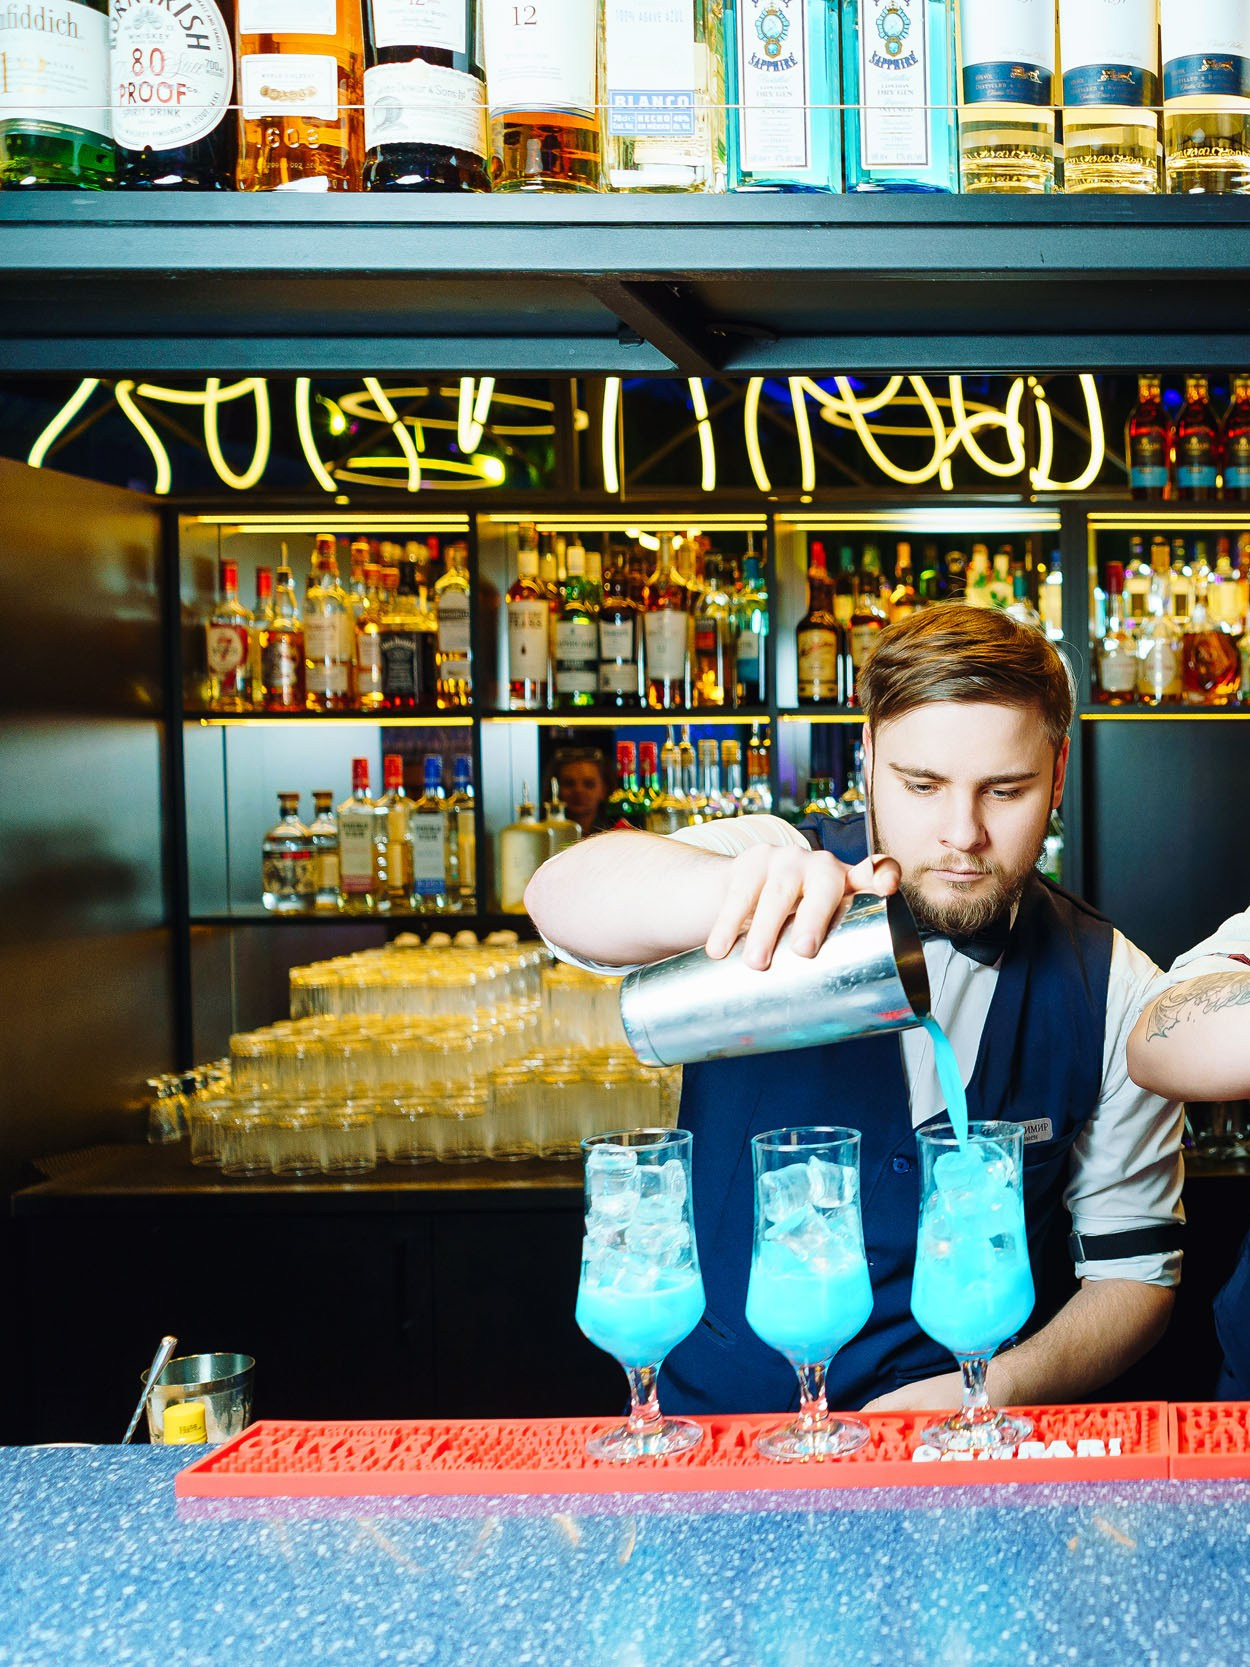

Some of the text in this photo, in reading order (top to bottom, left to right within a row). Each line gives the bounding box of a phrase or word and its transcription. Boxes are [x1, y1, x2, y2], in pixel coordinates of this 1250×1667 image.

[0, 3, 79, 39] fiddich
[513, 5, 538, 27] 12
[131, 47, 166, 77] 80
[748, 52, 799, 72] SAPPHIRE
[868, 51, 919, 71] SAPPHIRE
[119, 81, 187, 105] PROOF
[1024, 1122, 1049, 1135] ИМИР
